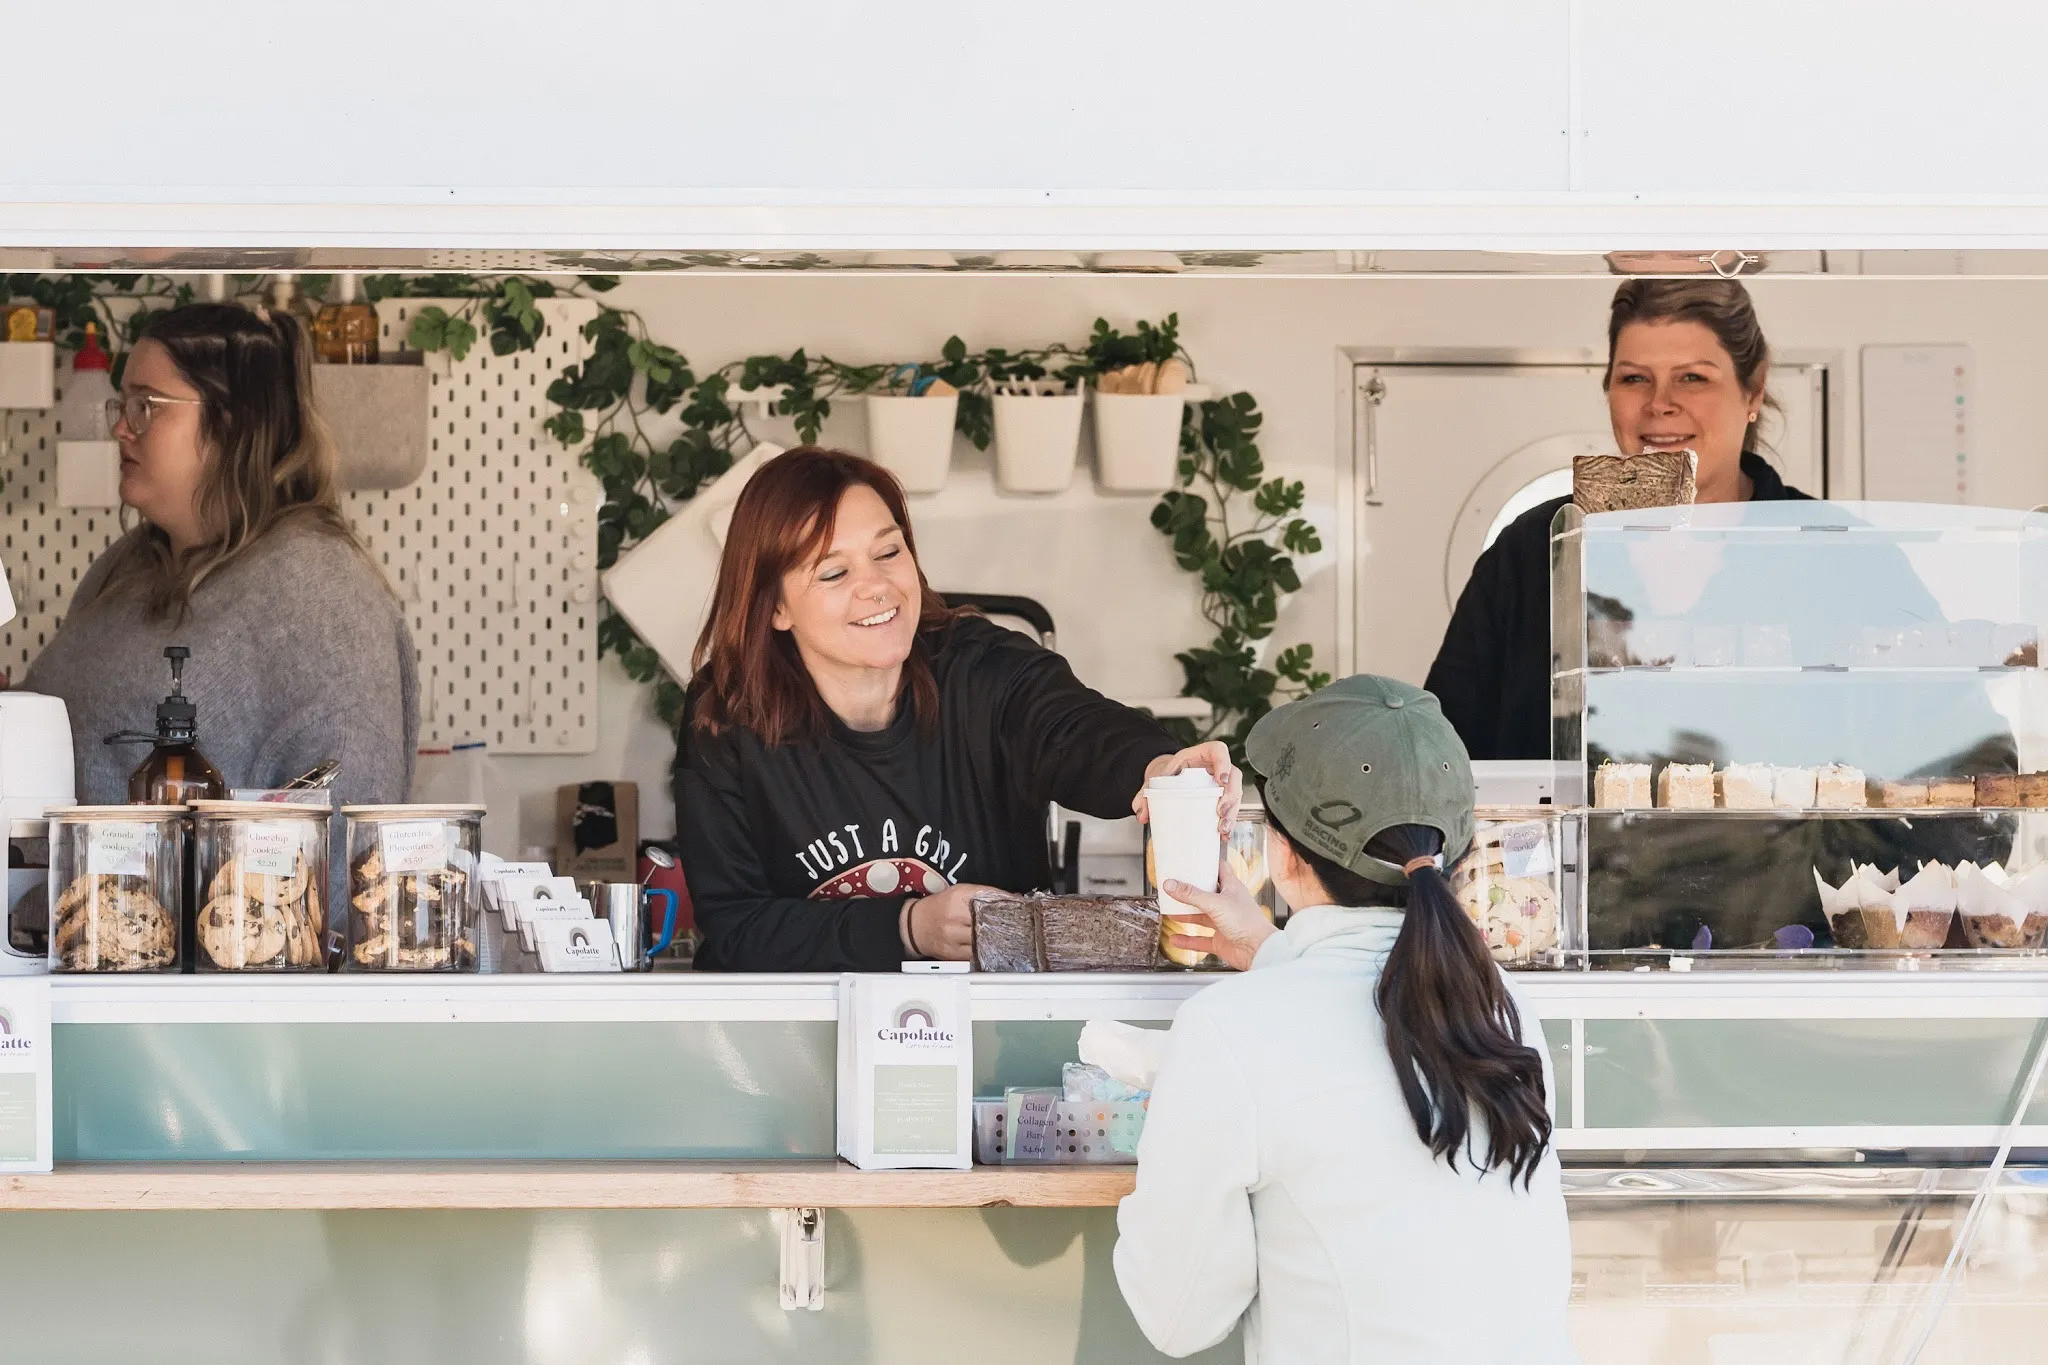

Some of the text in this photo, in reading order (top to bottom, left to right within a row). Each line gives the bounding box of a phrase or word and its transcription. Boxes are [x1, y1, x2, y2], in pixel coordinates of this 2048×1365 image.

[102, 829, 134, 839] Granola
[249, 832, 289, 844] Choc chip
[389, 830, 417, 839] Gluten
[1305, 819, 1348, 853] RACING
[101, 842, 131, 852] cookies
[252, 846, 282, 856] cookies
[389, 843, 435, 853] Florentines
[795, 818, 968, 885] JUST A GIRL
[256, 859, 277, 868] $2.20
[565, 946, 600, 956] Capolatte
[877, 1028, 954, 1044] Capolatte
[1025, 1102, 1049, 1112] Chief
[1017, 1116, 1054, 1128] Collagen
[1026, 1130, 1045, 1140] Bars
[1022, 1144, 1046, 1154] $4.60
